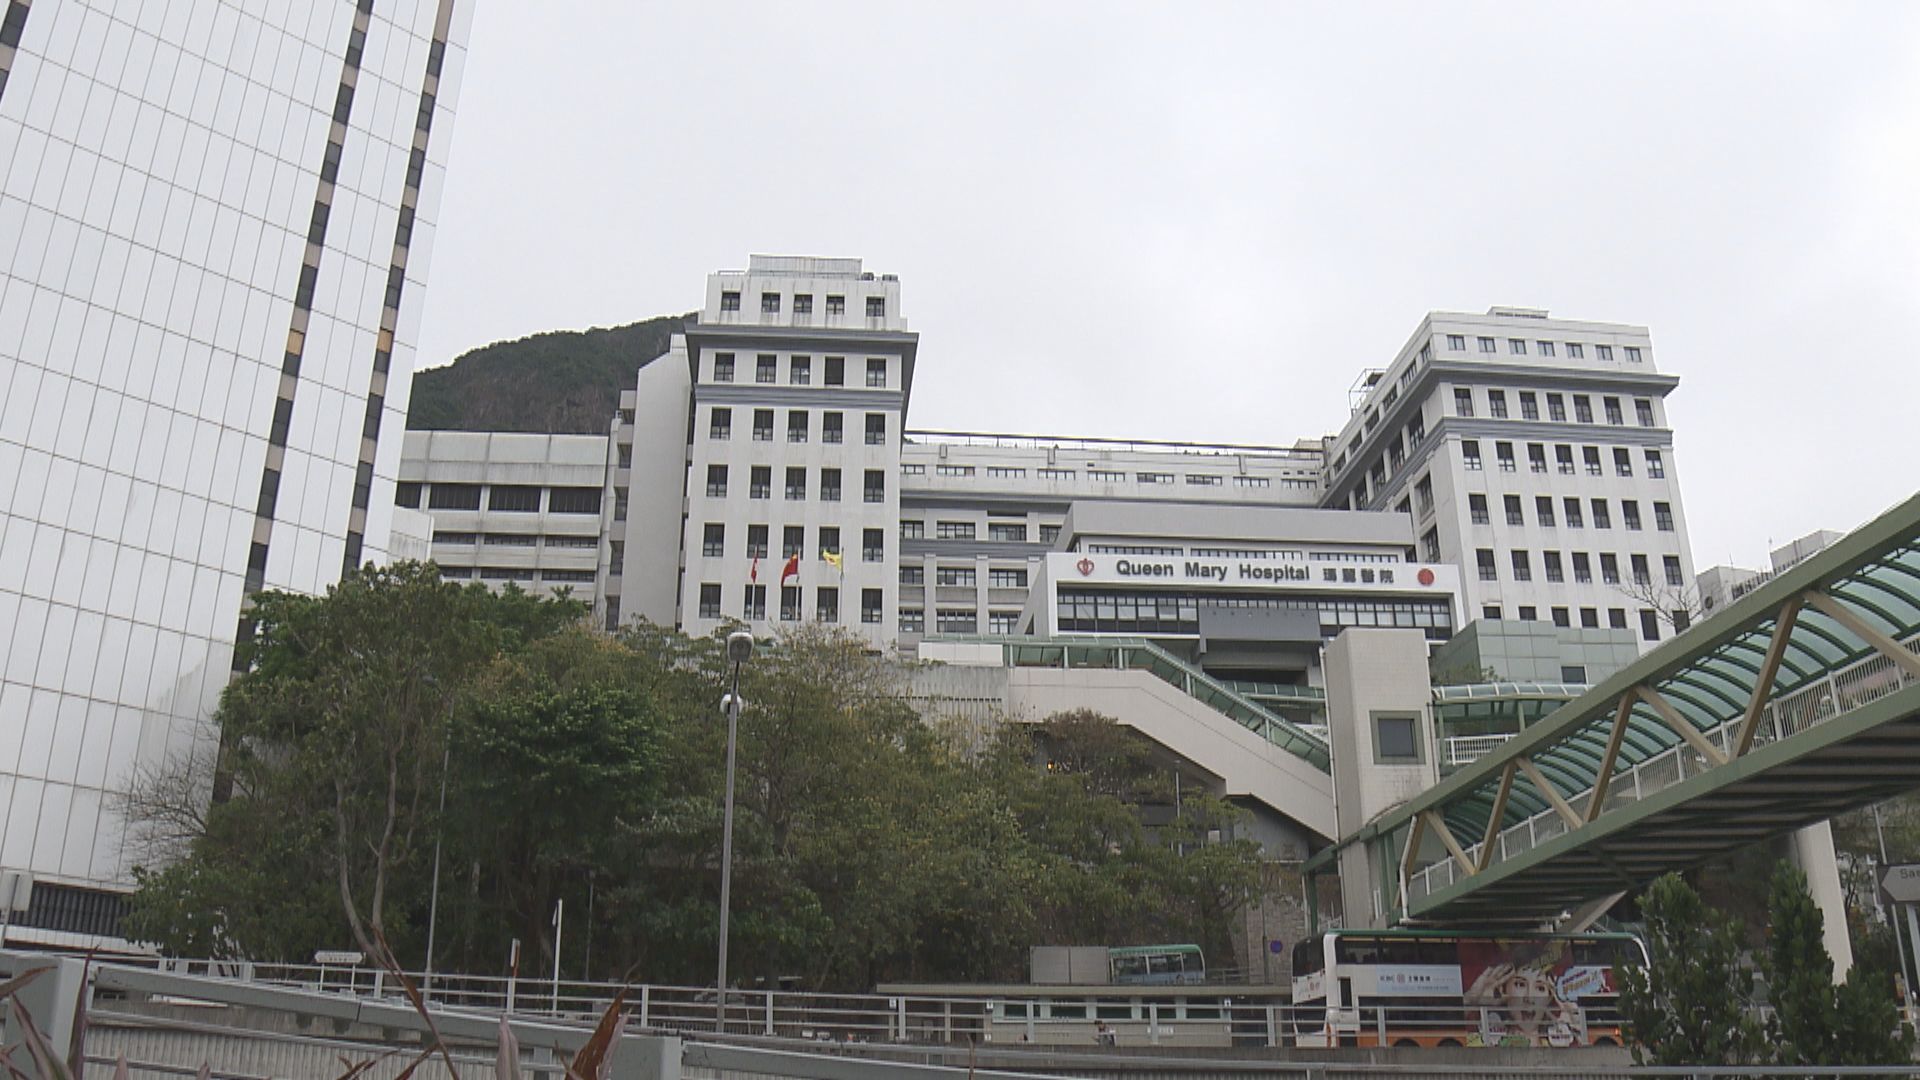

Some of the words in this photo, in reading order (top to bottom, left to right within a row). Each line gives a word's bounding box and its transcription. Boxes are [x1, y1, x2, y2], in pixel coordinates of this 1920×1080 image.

[1116, 559, 1174, 577] Queen
[1185, 562, 1228, 581] Mary
[1239, 564, 1310, 583] Hospital
